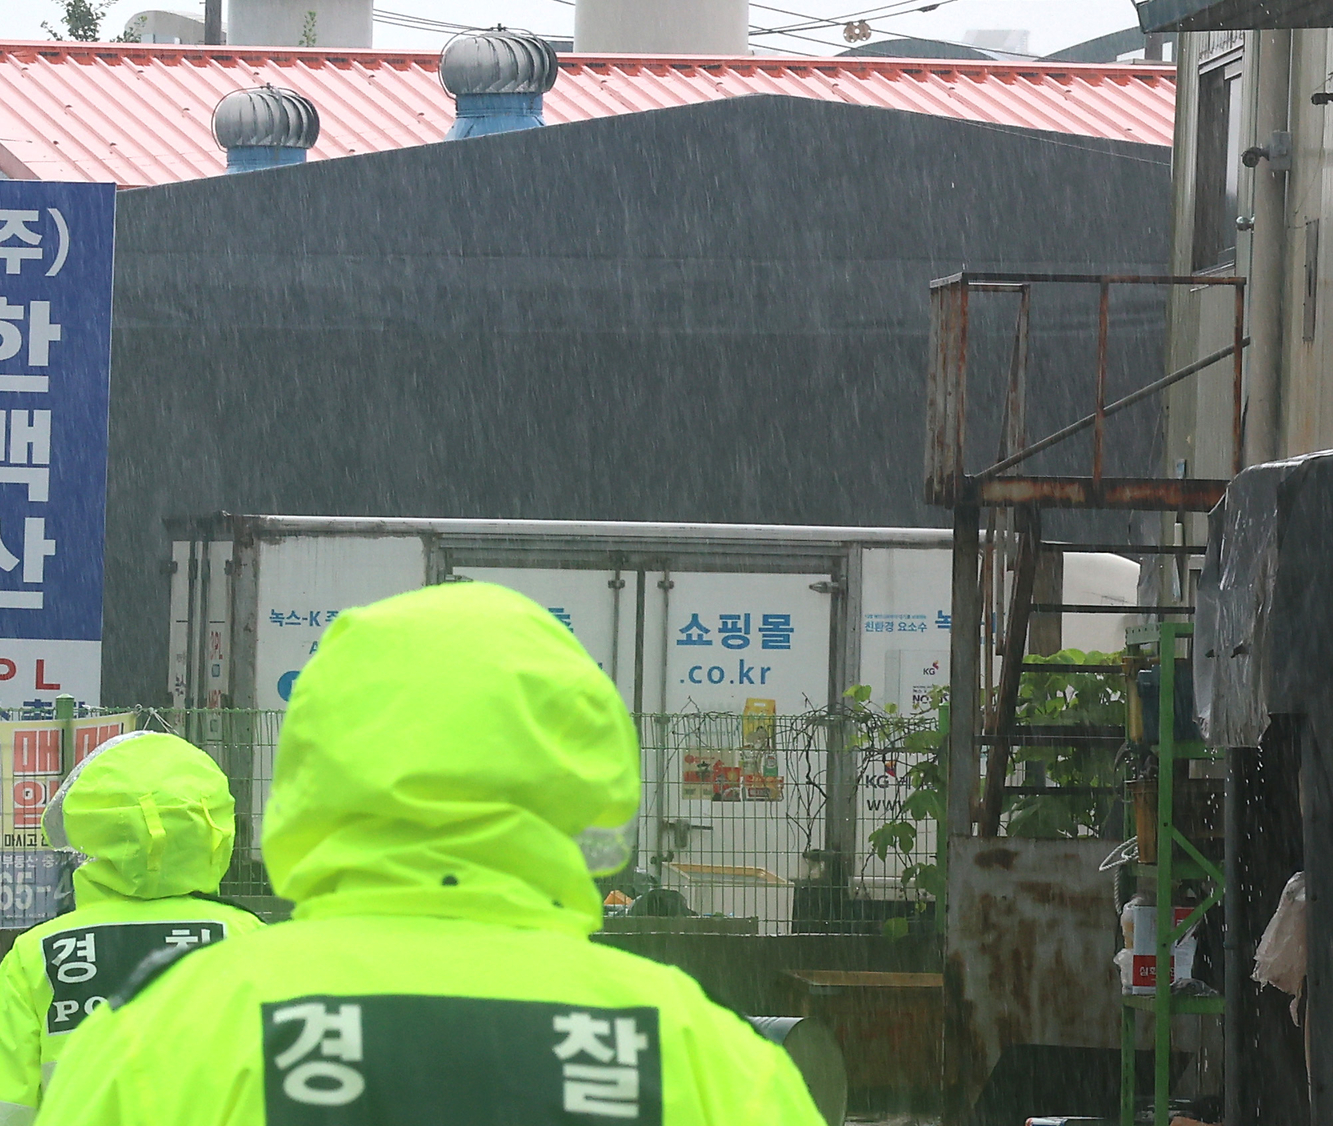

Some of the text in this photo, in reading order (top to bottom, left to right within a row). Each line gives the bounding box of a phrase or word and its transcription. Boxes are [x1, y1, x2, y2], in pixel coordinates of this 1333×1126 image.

[270, 609, 322, 629] 녹스-K
[676, 613, 794, 650] 쇼핑몰
[898, 621, 928, 633] 요소수
[680, 659, 771, 685] .co.kr
[923, 667, 935, 676] KG
[865, 775, 890, 788] KG
[5, 832, 38, 847] 마시고
